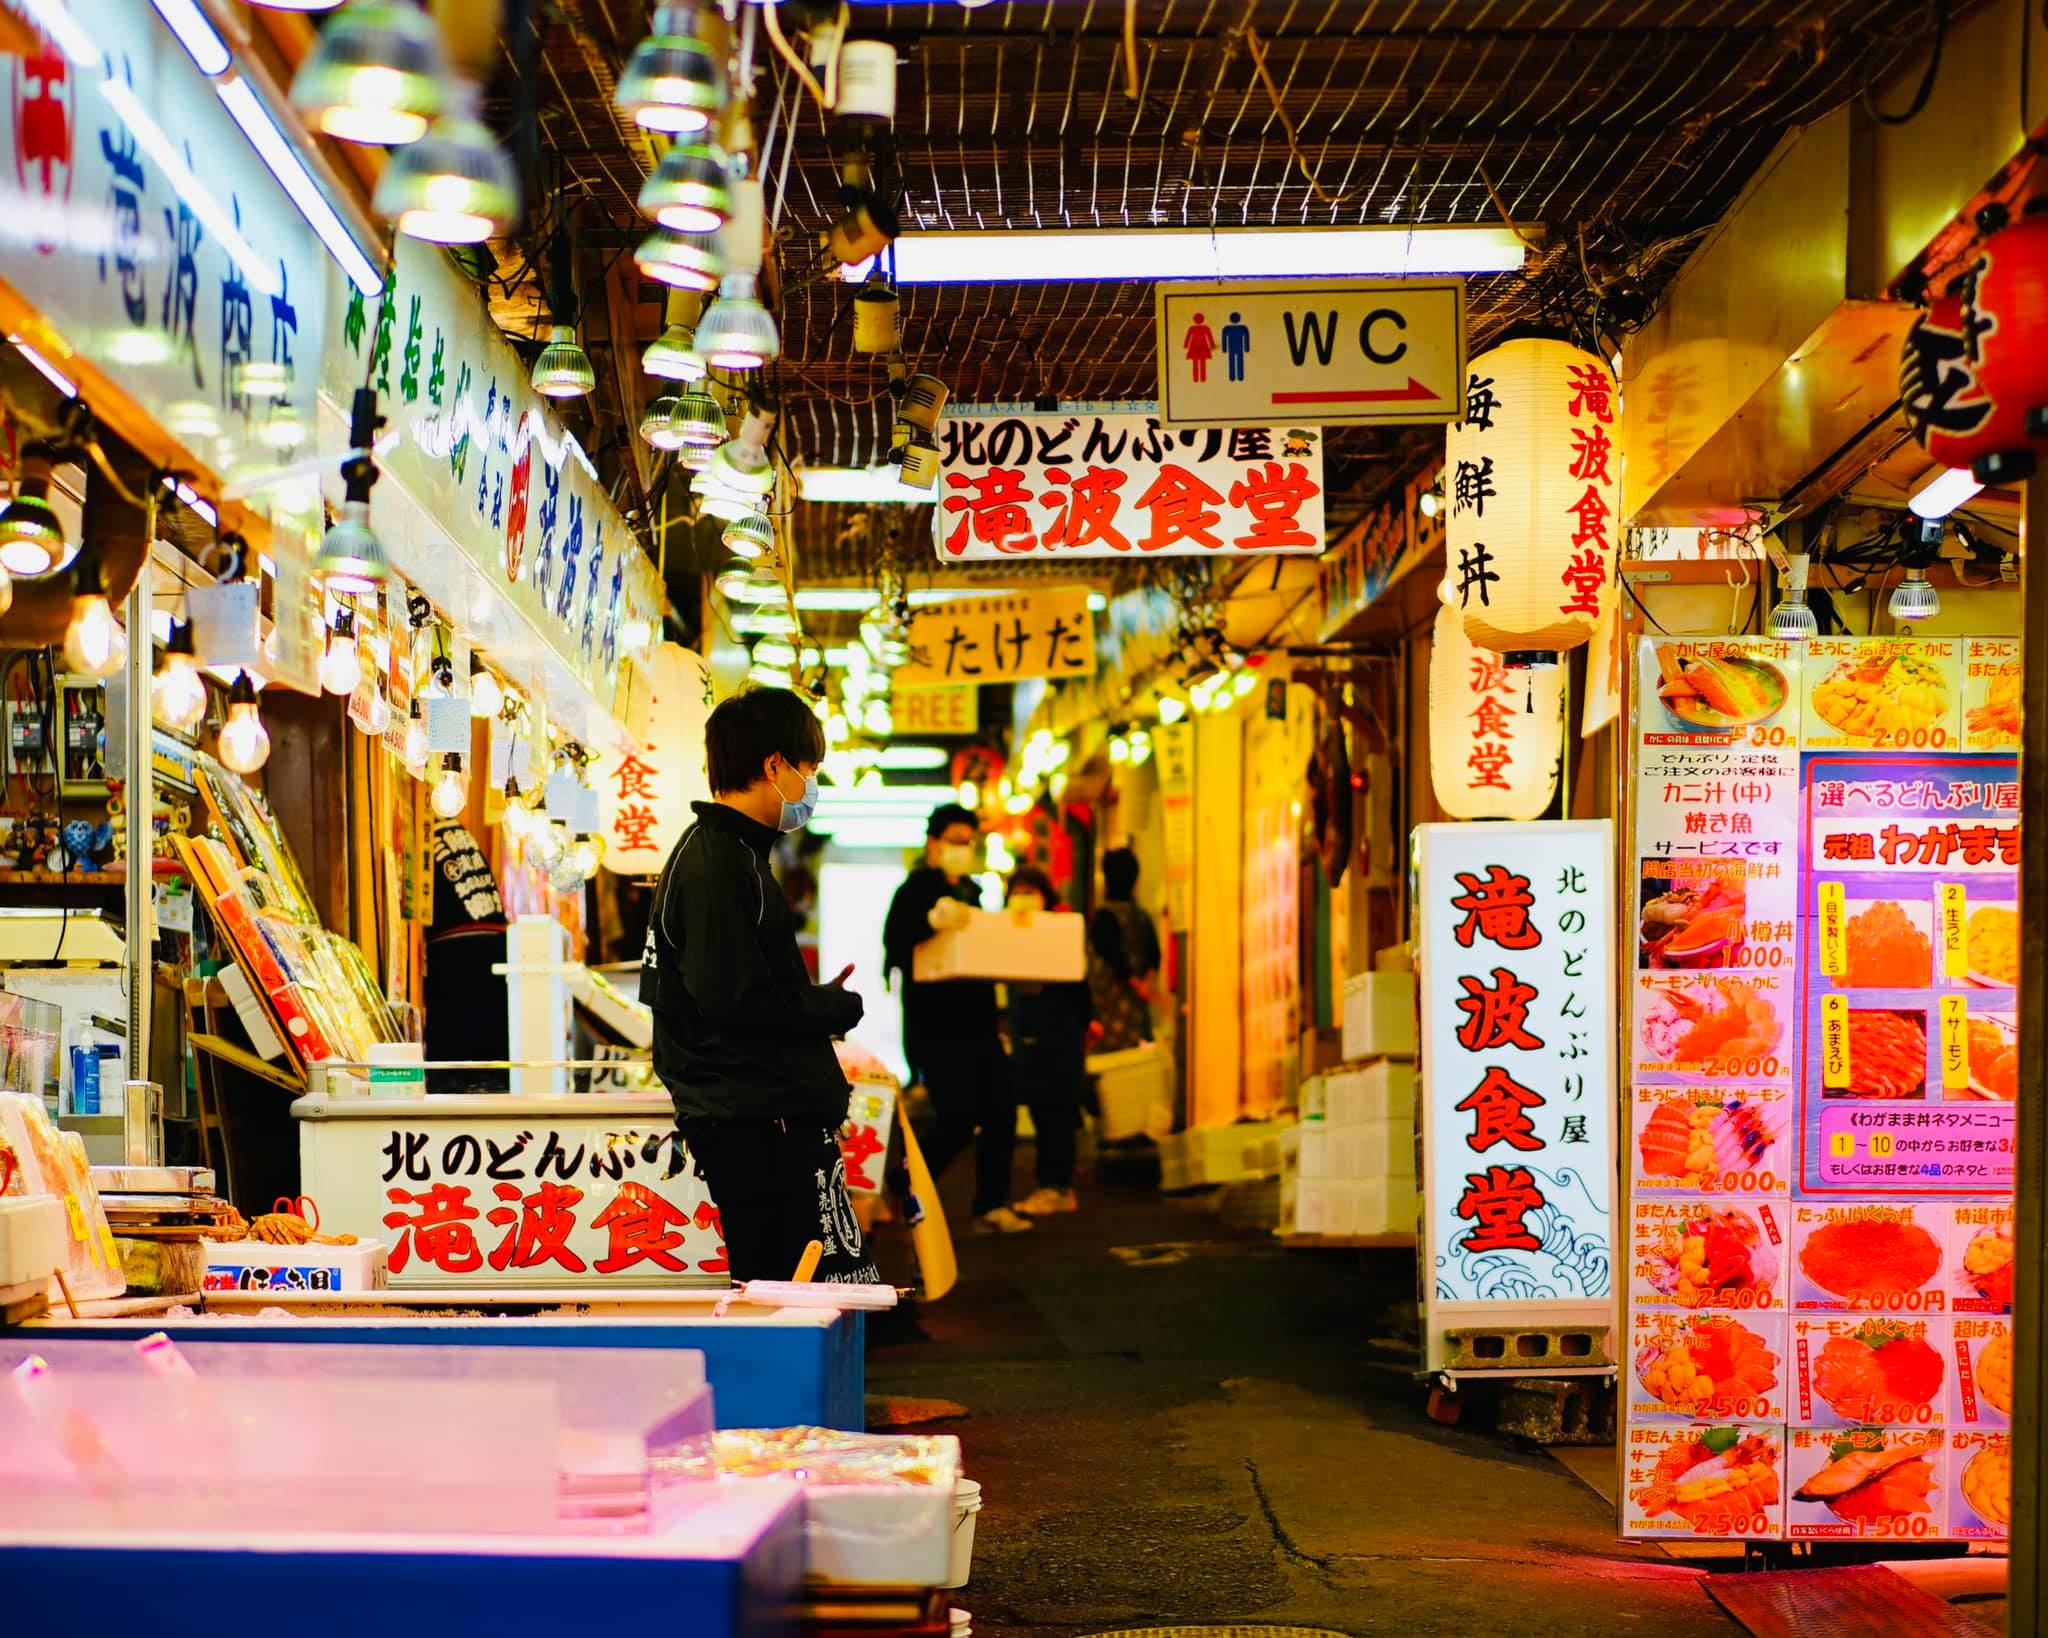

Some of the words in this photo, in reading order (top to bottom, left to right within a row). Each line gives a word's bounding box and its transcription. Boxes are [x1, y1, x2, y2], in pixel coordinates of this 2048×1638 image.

[1284, 309, 1408, 367] WC
[1455, 373, 1502, 609] 海鮮丼
[1558, 364, 1613, 617] 滝波食堂
[943, 462, 1320, 555] 滝波食堂
[944, 613, 1085, 677] たけだ
[1676, 642, 1790, 659] かに屋のかに汁
[1467, 640, 1517, 791] 波食堂
[1644, 766, 1796, 777] ご注文のお客様に
[1820, 782, 2019, 809] 選べるどんぶり屋
[1685, 812, 1752, 834] 焼き魚
[1654, 841, 1783, 855] サービスです
[1824, 834, 1875, 860] 元祖
[1727, 920, 1793, 943] 小樽丼
[1946, 908, 1960, 951] 生うに
[1556, 866, 1590, 1145] 北のどんぶり屋
[1450, 864, 1547, 1254] 滝波食堂
[1828, 1019, 1843, 1074] あまえび
[1947, 1018, 1962, 1072] サーモン
[1639, 1088, 1786, 1103] 生うに・甘えび・サーモン
[382, 1130, 704, 1182] 北のどんぶり
[1636, 1224, 1678, 1238] 生うに
[1635, 1264, 1663, 1278] かに
[1630, 1449, 1687, 1464] サーモン
[1629, 1469, 1672, 1482] 生うに
